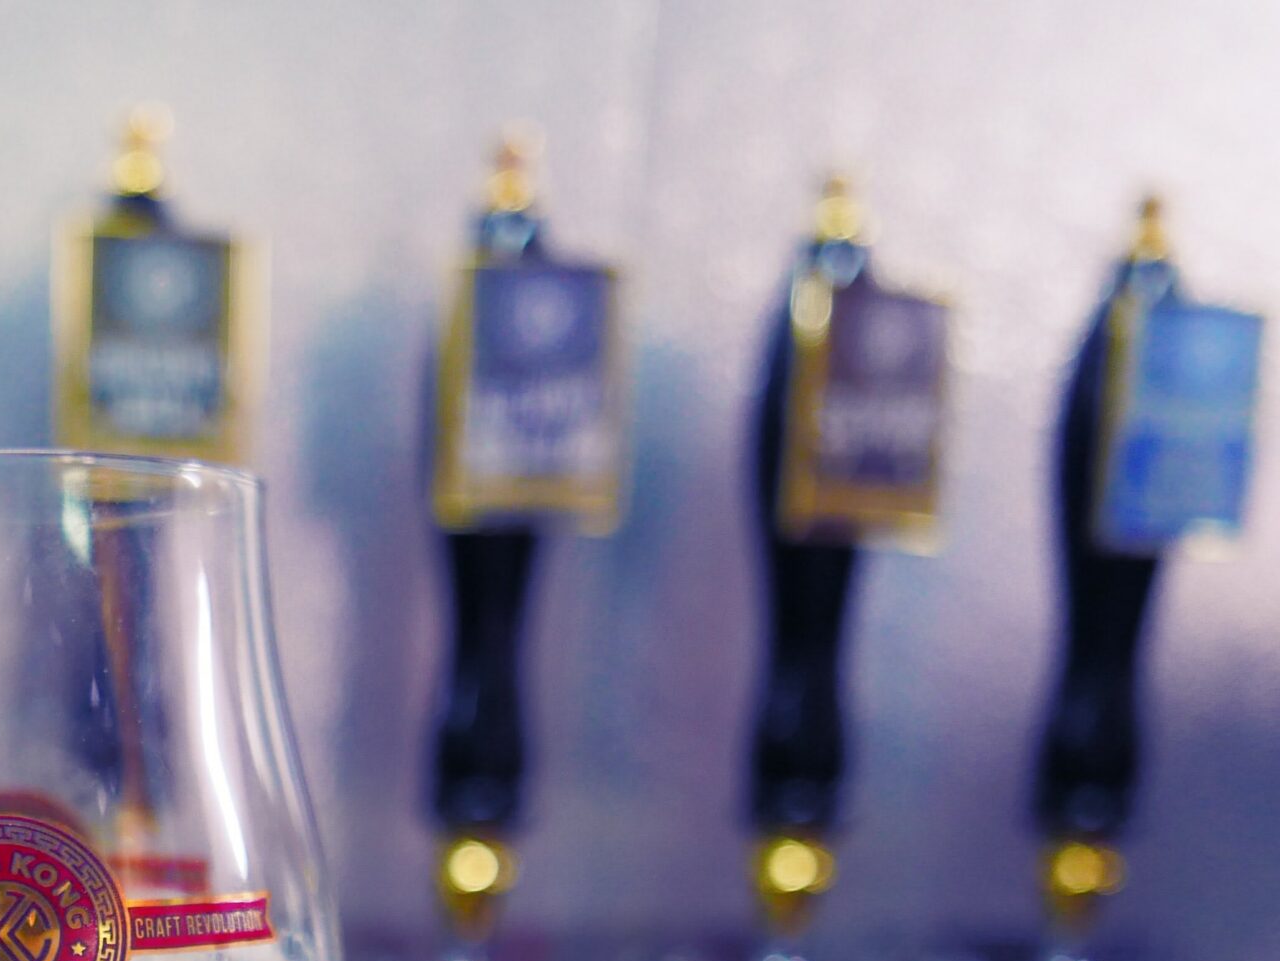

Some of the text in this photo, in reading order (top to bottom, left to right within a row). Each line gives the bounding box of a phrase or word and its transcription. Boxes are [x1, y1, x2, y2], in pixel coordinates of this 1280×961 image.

[9, 852, 91, 930] KONG
[134, 909, 263, 939] CRAFT REVOLUTION
